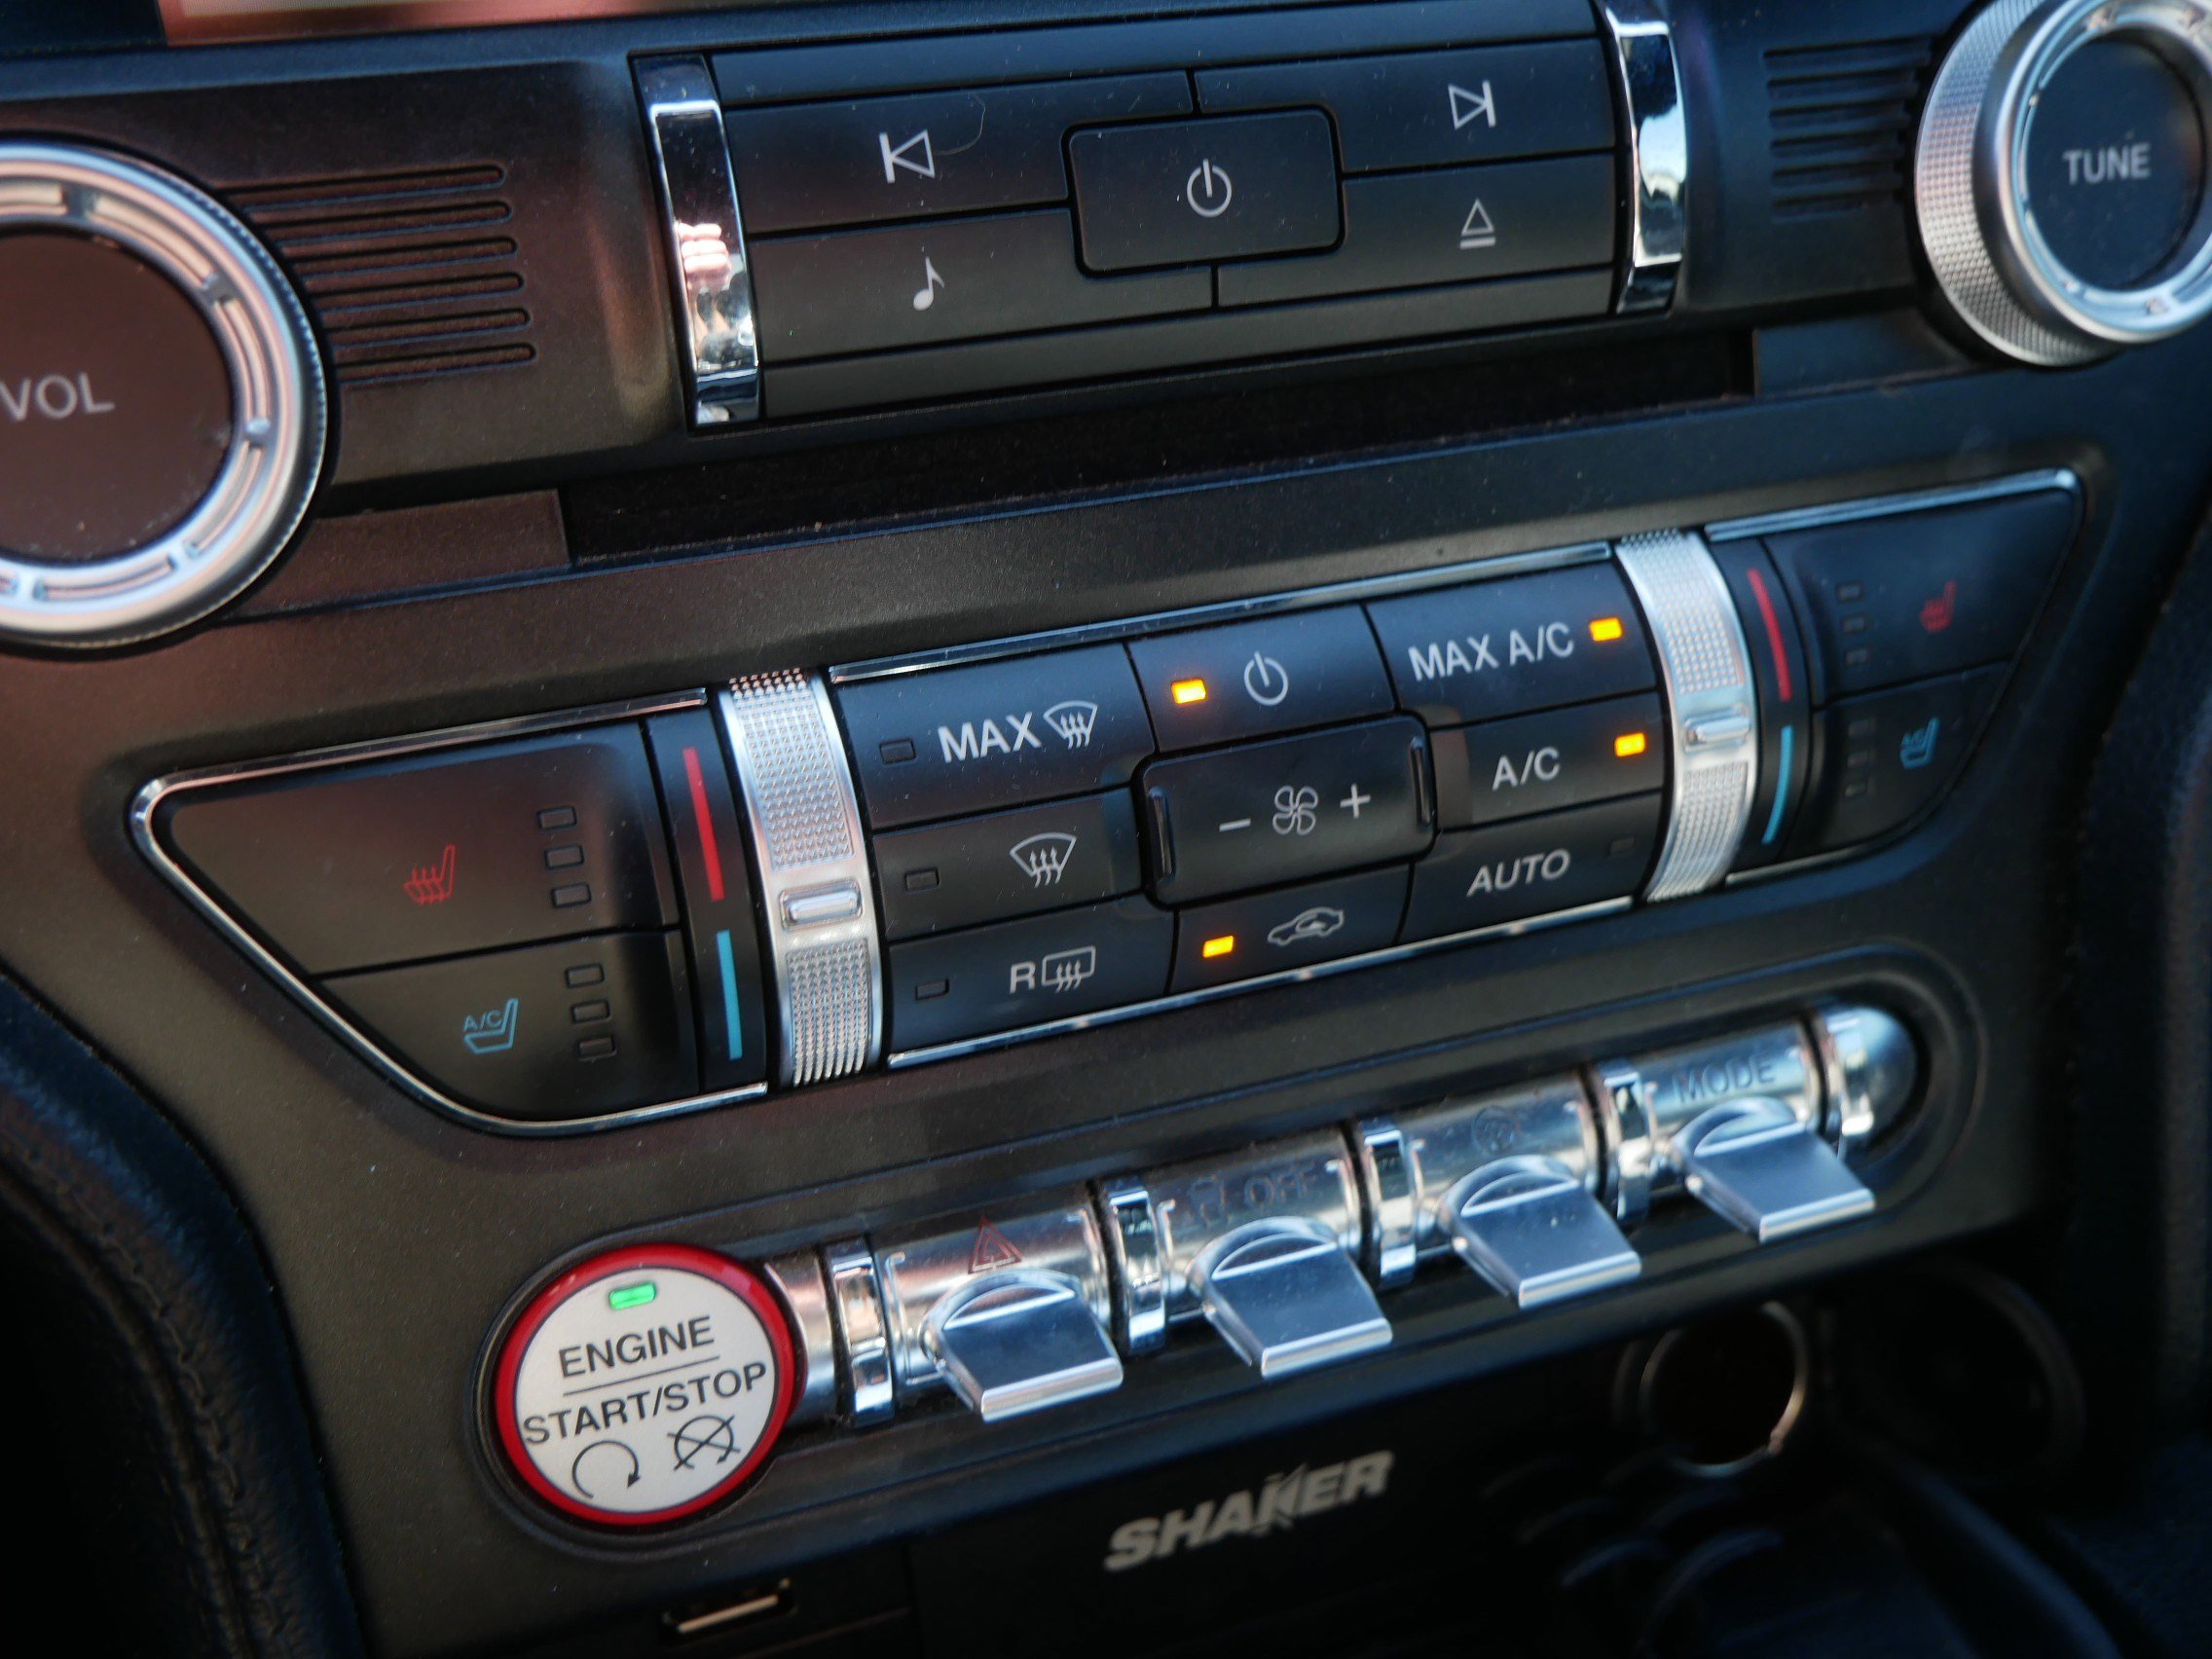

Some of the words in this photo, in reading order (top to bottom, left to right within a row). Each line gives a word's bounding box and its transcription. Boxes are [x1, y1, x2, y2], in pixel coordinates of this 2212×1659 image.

[2062, 142, 2151, 185] TUNE
[0, 372, 115, 422] VOL
[1408, 636, 1498, 682] MAX
[1509, 621, 1574, 666] A/C
[938, 712, 1042, 763] MAX
[1493, 747, 1561, 791] A/C
[1466, 849, 1571, 897] AUTO
[1010, 962, 1036, 994] R
[462, 1010, 502, 1032] A/C
[1671, 1054, 1776, 1103] MODE
[559, 1315, 715, 1379] ENGINE
[524, 1362, 767, 1445] START/STOP
[1104, 1450, 1394, 1572] SHAKER
